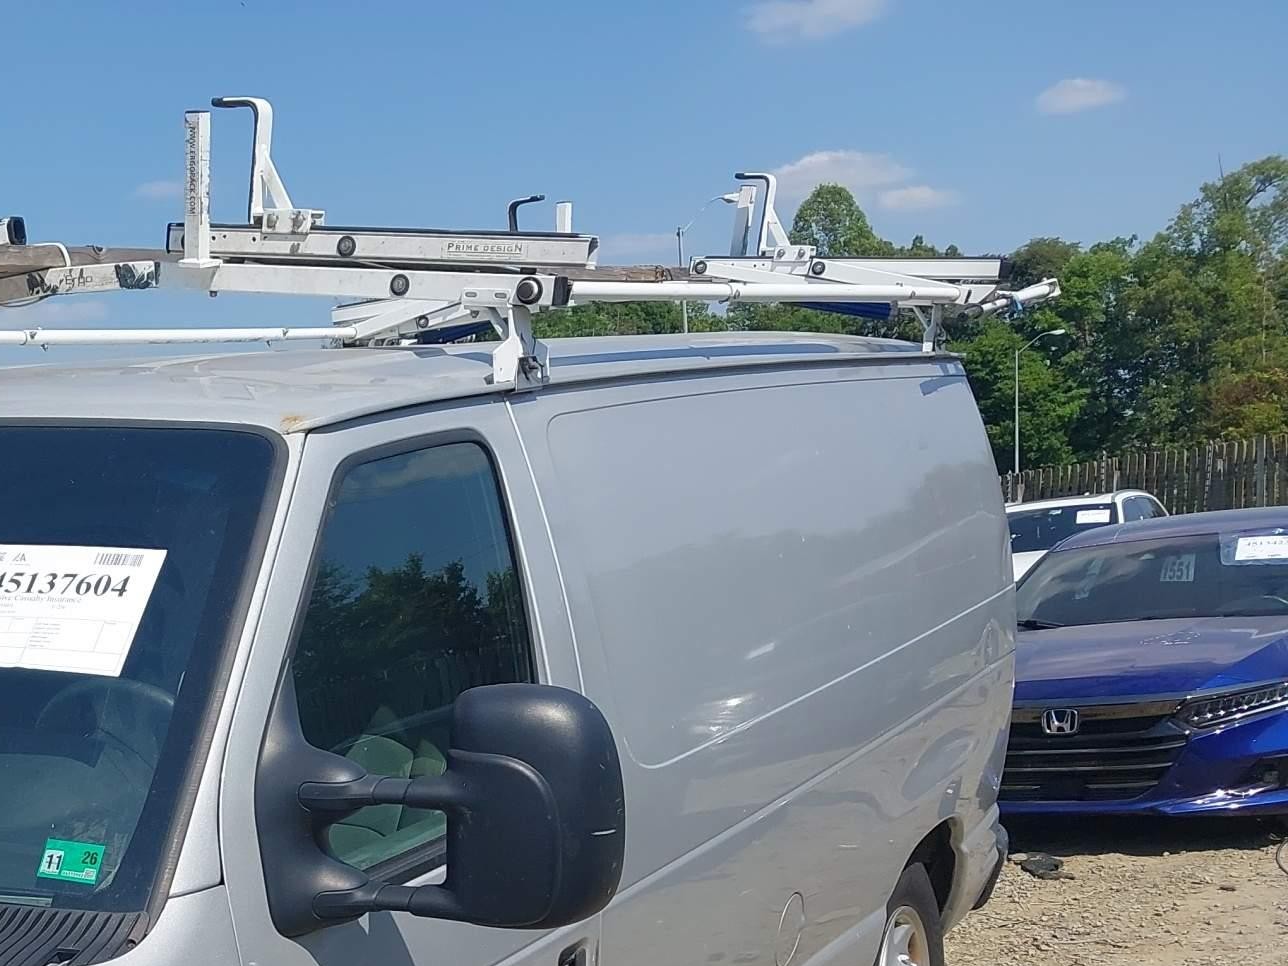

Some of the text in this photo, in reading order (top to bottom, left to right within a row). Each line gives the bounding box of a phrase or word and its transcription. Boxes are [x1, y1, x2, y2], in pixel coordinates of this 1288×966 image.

[447, 242, 523, 253] PRIME DESIGN
[47, 851, 99, 871] 11 26
